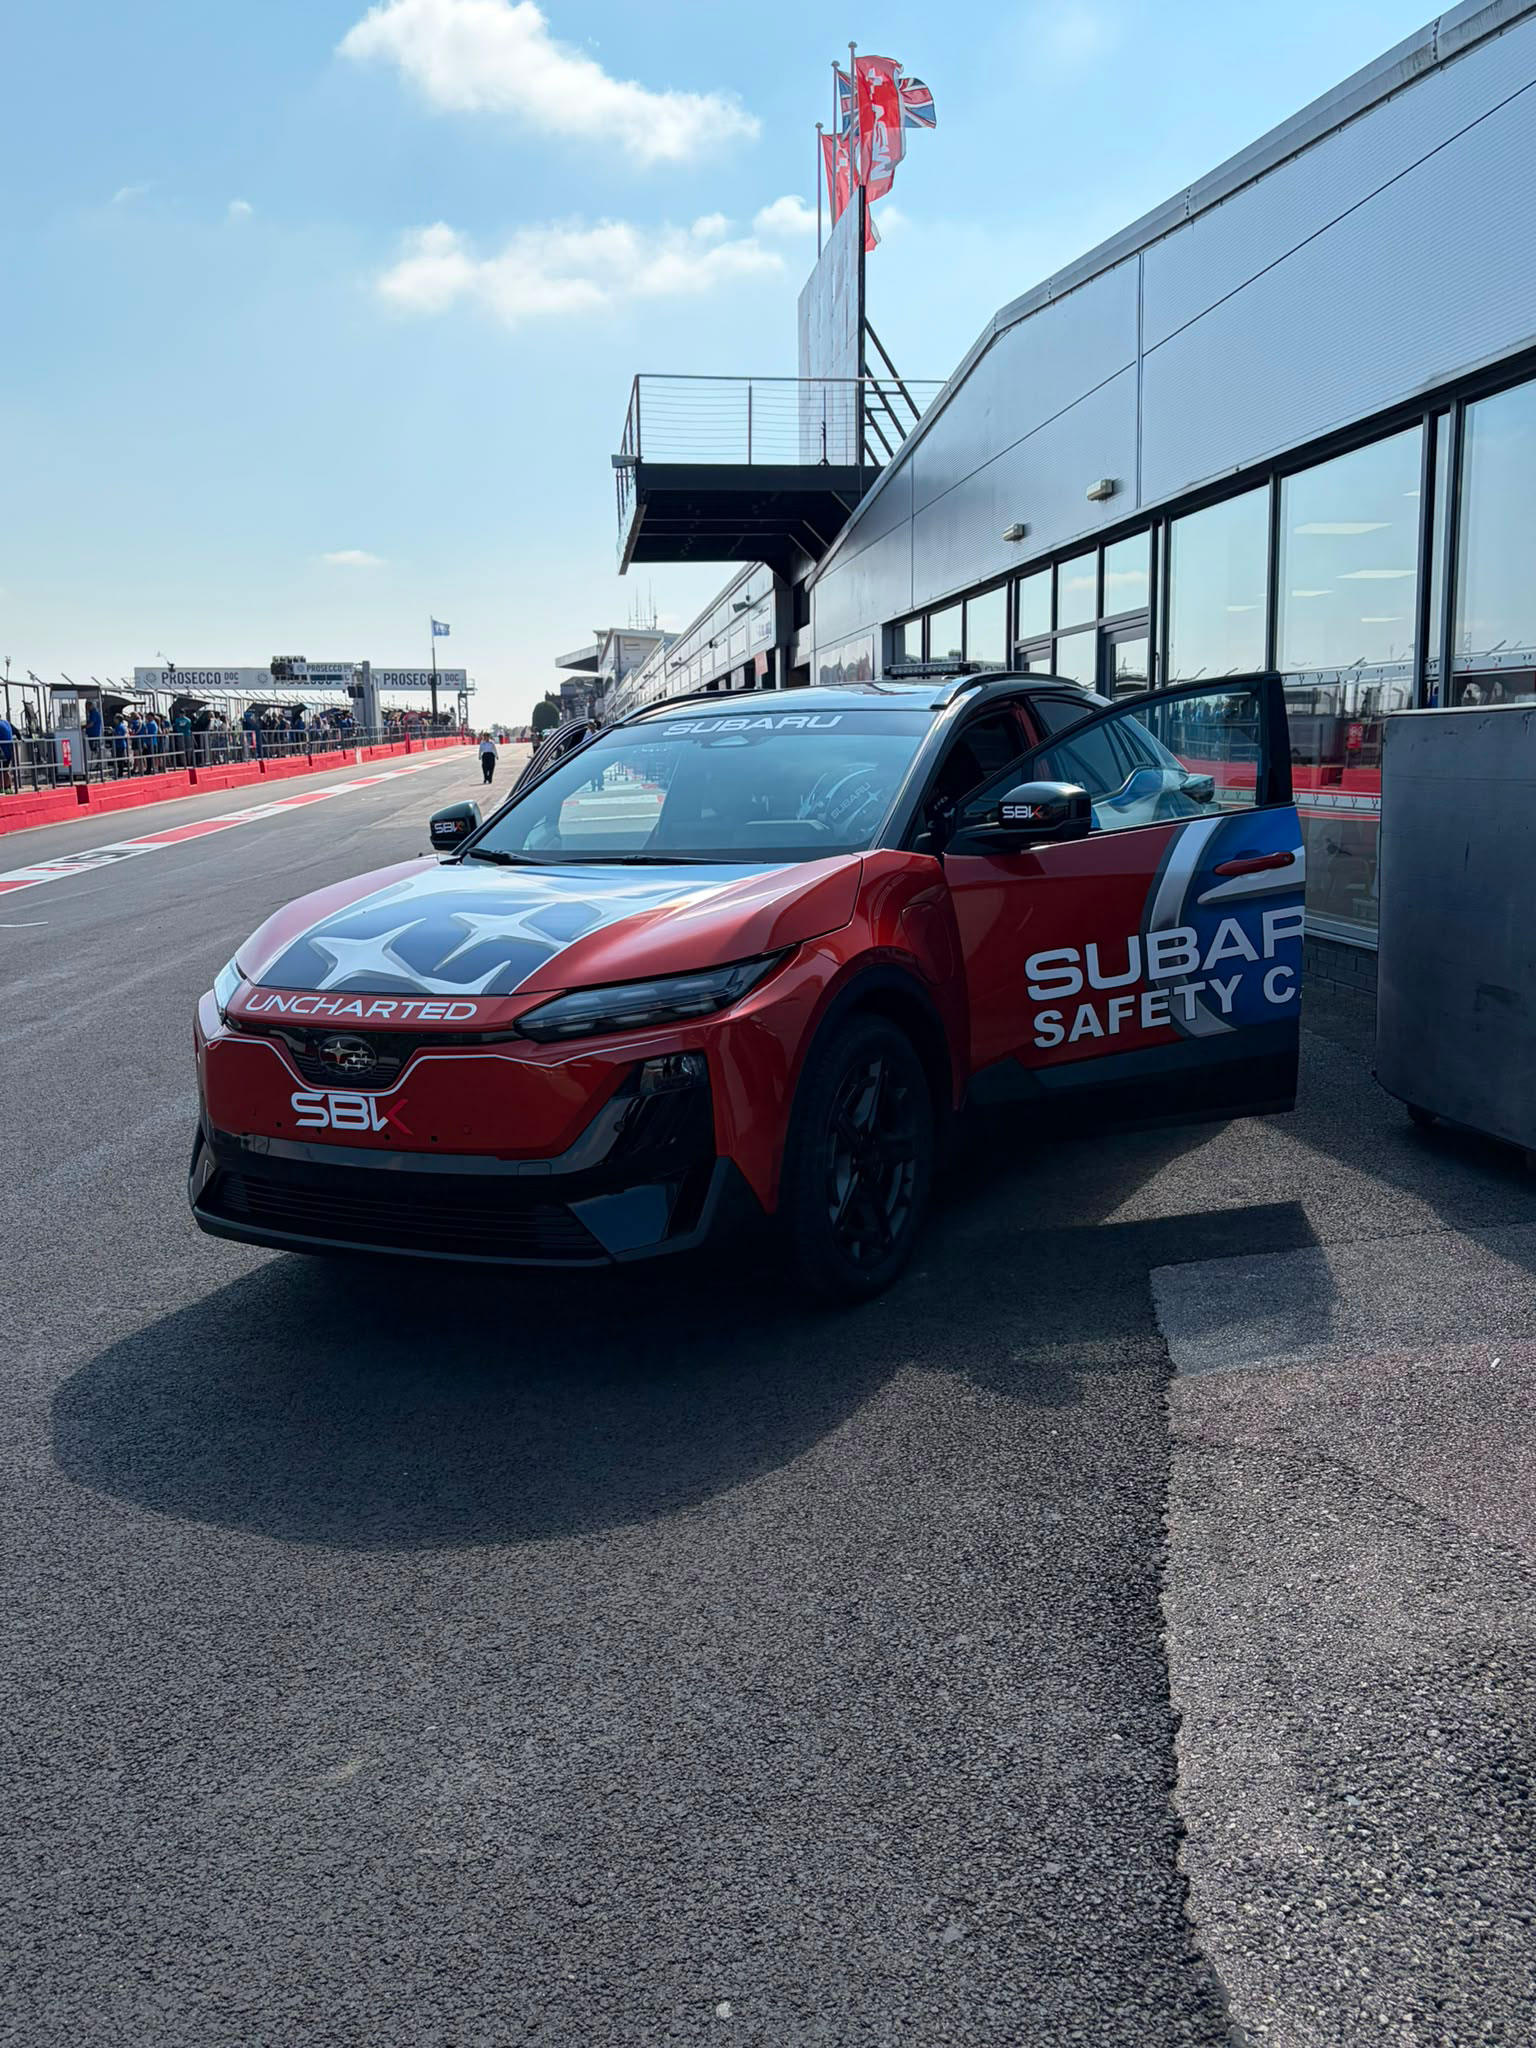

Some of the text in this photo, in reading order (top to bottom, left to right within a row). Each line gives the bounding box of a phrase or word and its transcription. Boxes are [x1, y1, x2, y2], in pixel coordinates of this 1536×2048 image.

[306, 664, 342, 672] PROSECCO
[161, 671, 239, 685] PROSECCO DOC
[445, 673, 460, 682] DOC
[662, 715, 843, 736] SUBARU
[830, 782, 872, 820] SUBARU
[1002, 805, 1043, 819] SBK
[434, 821, 464, 834] SBK
[245, 994, 478, 1021] UNCHARTED
[1033, 965, 1302, 1048] SAFETY C
[290, 1091, 413, 1136] SBK
